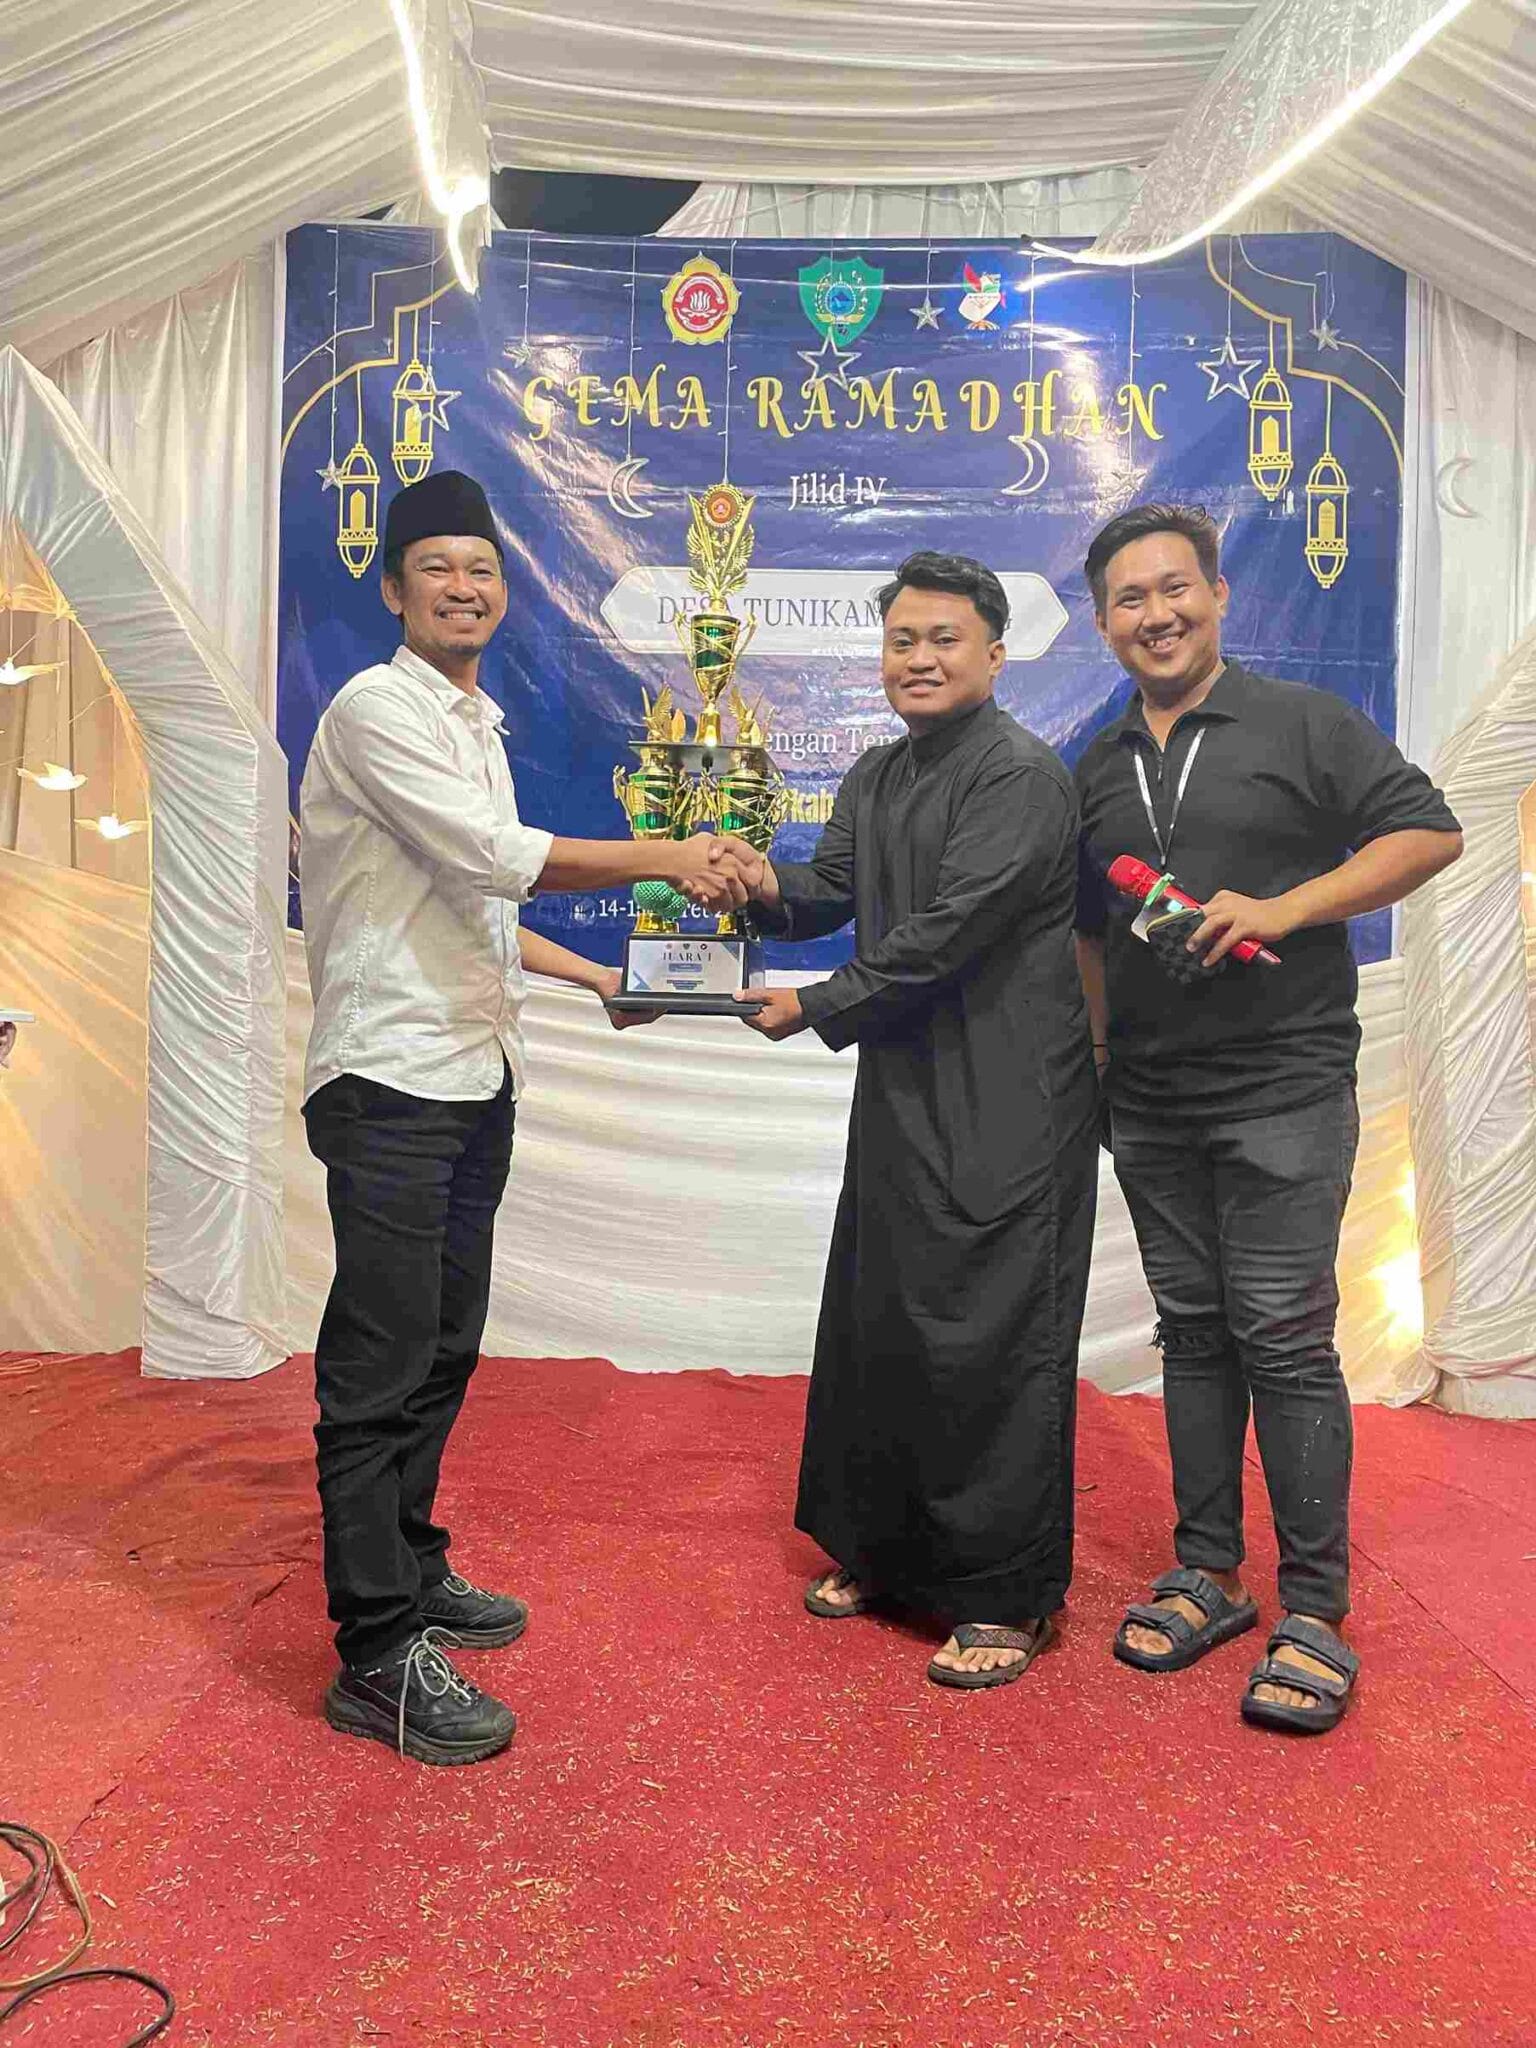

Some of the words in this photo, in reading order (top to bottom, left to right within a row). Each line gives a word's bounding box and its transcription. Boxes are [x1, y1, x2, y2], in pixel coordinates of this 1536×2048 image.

[523, 363, 712, 441] GEMA
[747, 366, 1167, 442] RAMADHAN
[788, 472, 846, 511] Jilid
[854, 476, 888, 505] IV
[764, 731, 838, 761] engan
[845, 727, 902, 753] Tem
